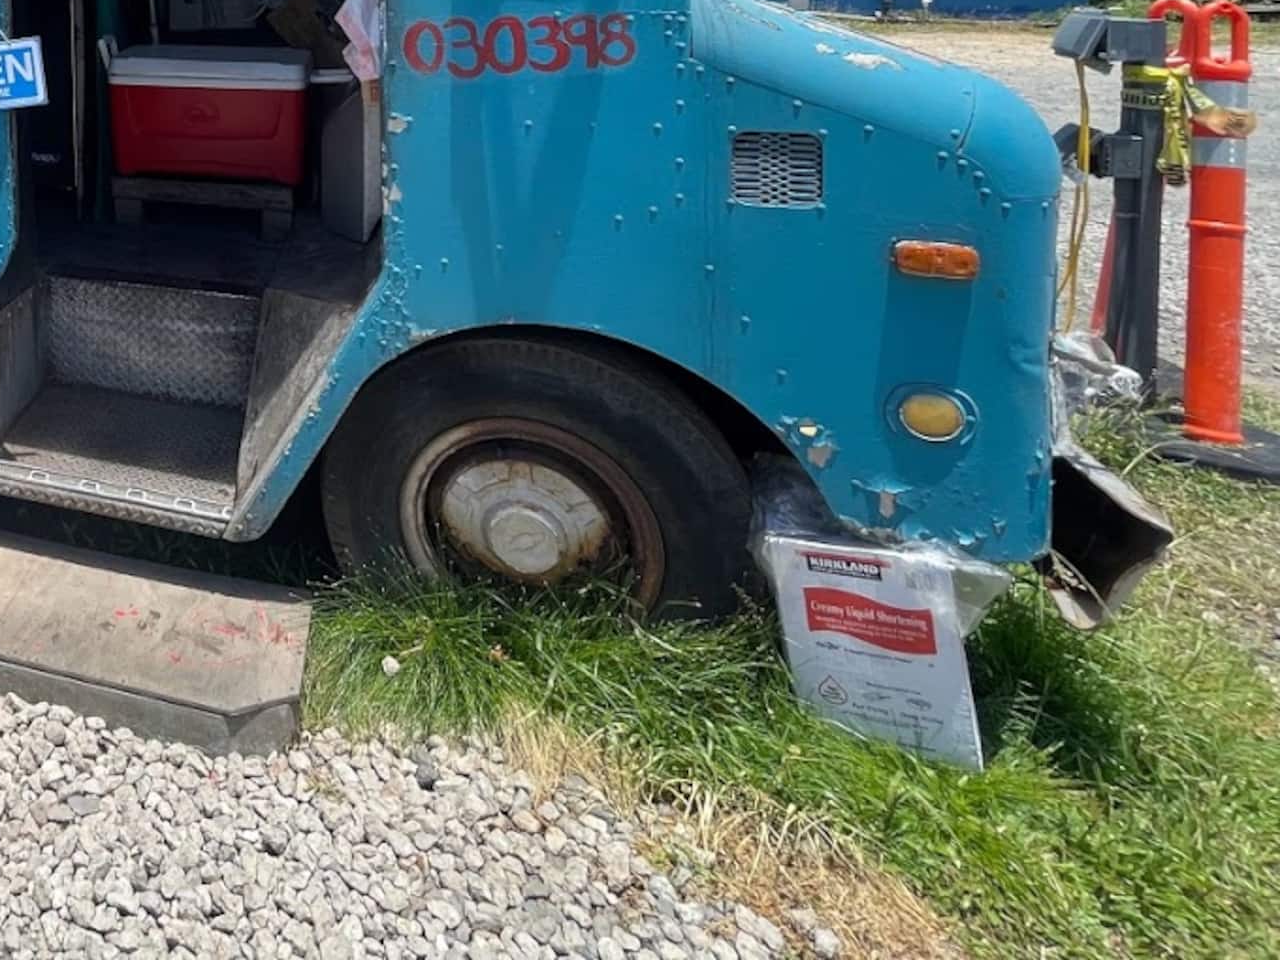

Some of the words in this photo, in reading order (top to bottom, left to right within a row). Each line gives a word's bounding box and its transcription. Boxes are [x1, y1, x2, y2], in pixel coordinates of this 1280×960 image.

[403, 12, 637, 80] 030398
[809, 556, 879, 574] KIRKLAND
[810, 600, 844, 618] Creamy
[845, 605, 874, 620] Liquid
[876, 610, 928, 632] Shortening
